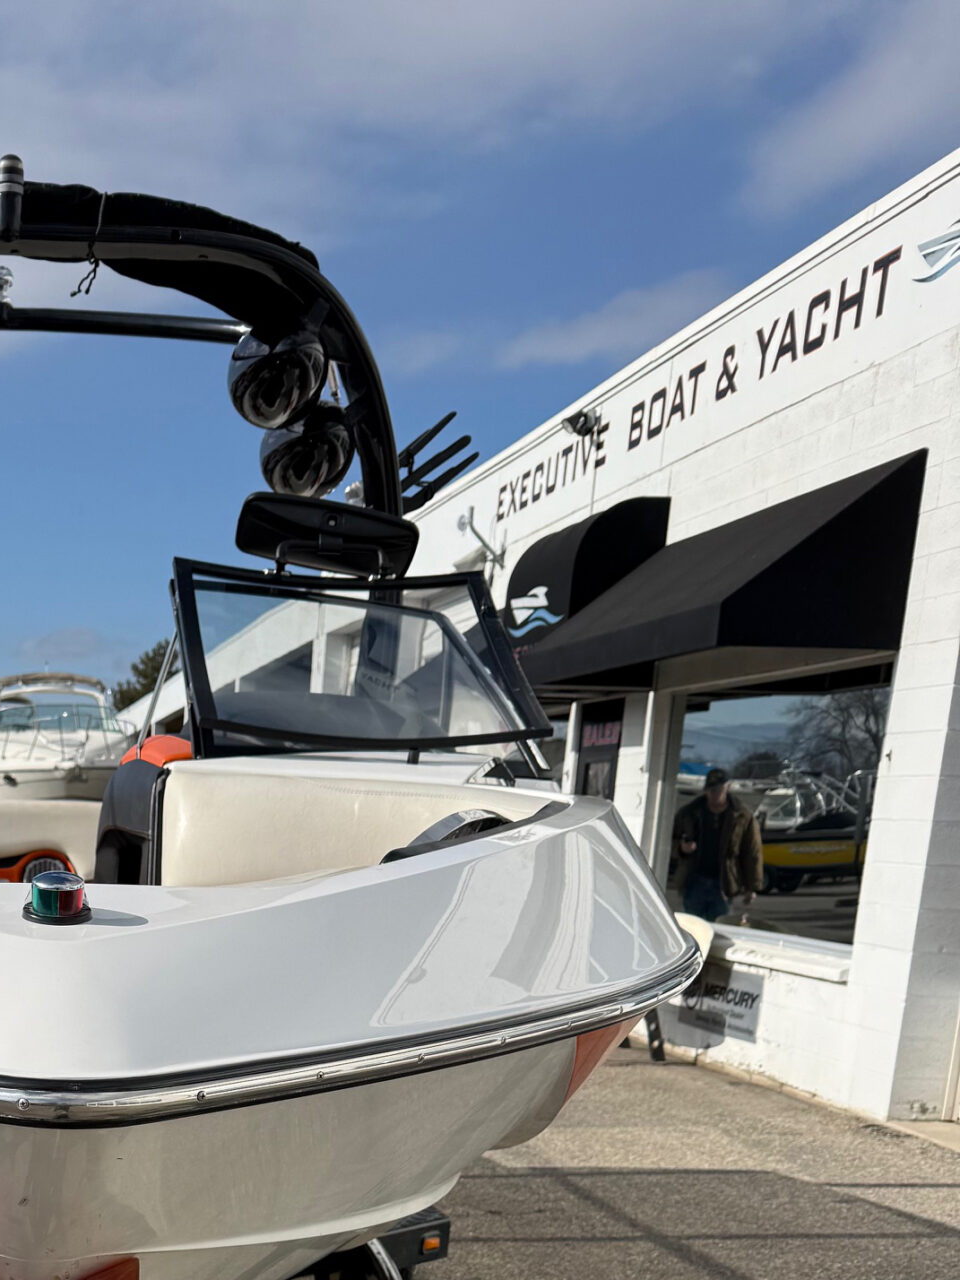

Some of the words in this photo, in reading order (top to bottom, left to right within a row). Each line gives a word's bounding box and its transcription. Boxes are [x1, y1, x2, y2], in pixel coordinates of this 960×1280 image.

[496, 421, 610, 523] EXECUTIVE
[627, 359, 707, 452] BOAT
[715, 344, 738, 401] &
[756, 244, 903, 381] YACHT
[703, 982, 759, 1010] MERCURY
